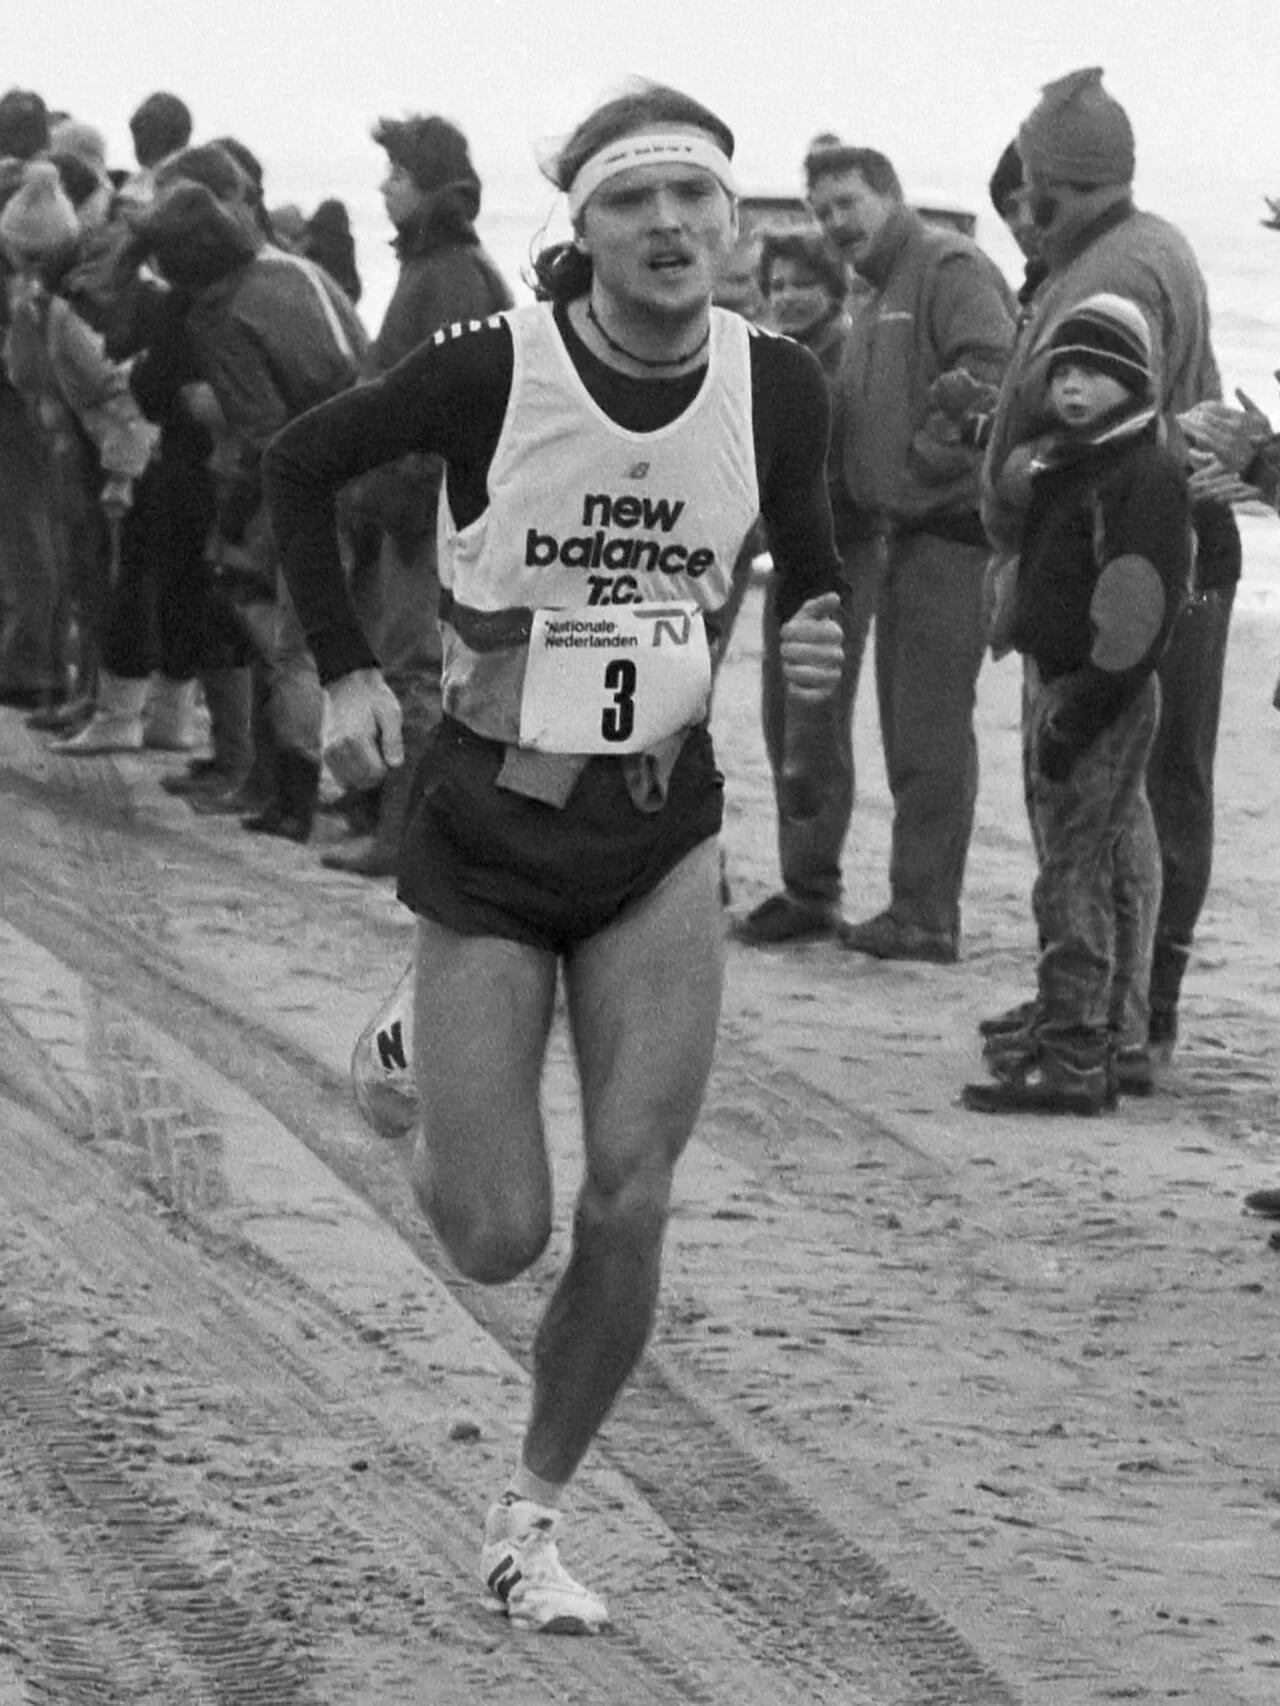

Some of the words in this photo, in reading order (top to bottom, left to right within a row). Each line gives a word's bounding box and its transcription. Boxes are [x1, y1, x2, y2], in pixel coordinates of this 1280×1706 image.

[582, 493, 686, 533] new
[525, 528, 715, 578] balance
[587, 574, 643, 606] T.C.
[545, 633, 638, 650] Nederlanden
[602, 659, 637, 743] 3
